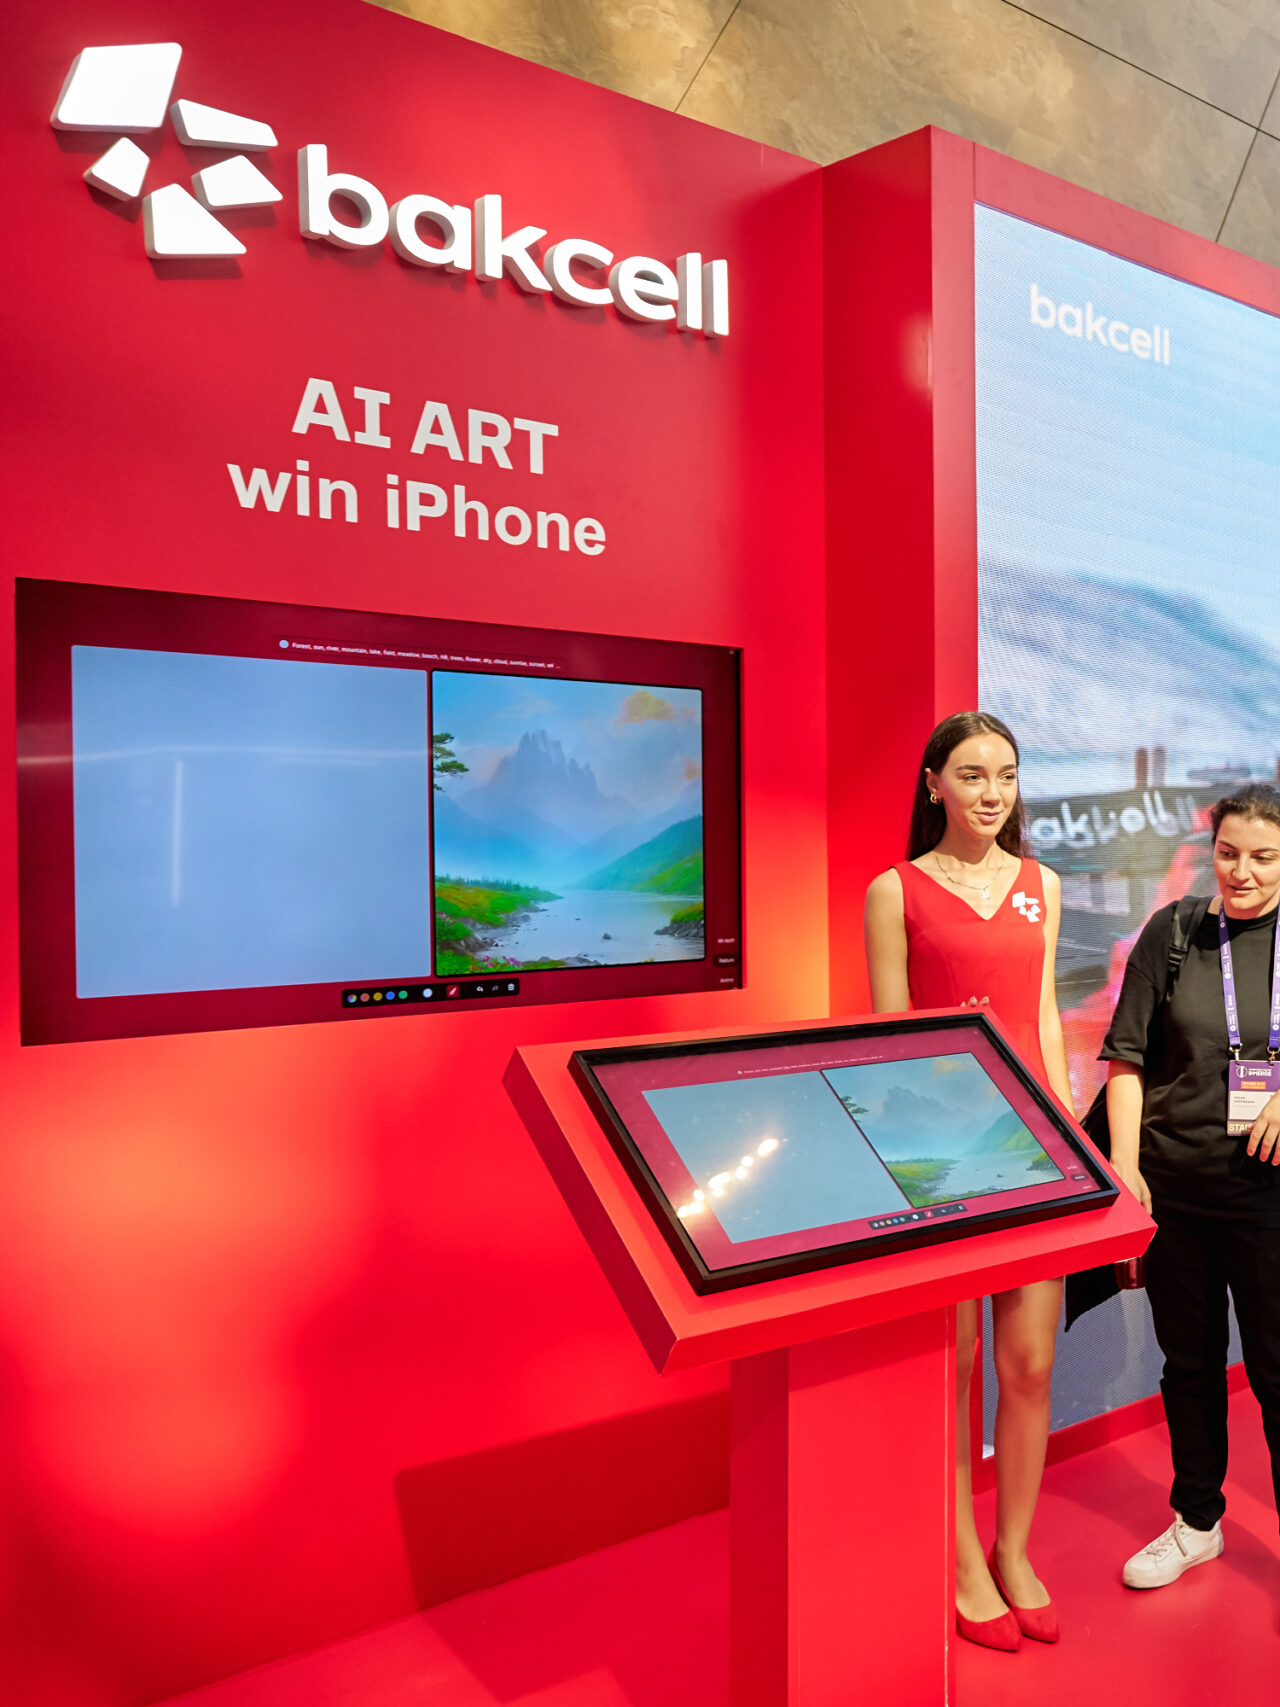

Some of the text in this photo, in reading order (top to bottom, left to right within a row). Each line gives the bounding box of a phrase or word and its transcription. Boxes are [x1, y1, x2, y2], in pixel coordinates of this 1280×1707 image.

[298, 144, 729, 337] bakcell
[1030, 283, 1170, 366] bakcell
[292, 377, 559, 476] AI ART
[227, 459, 607, 557] win iPhone
